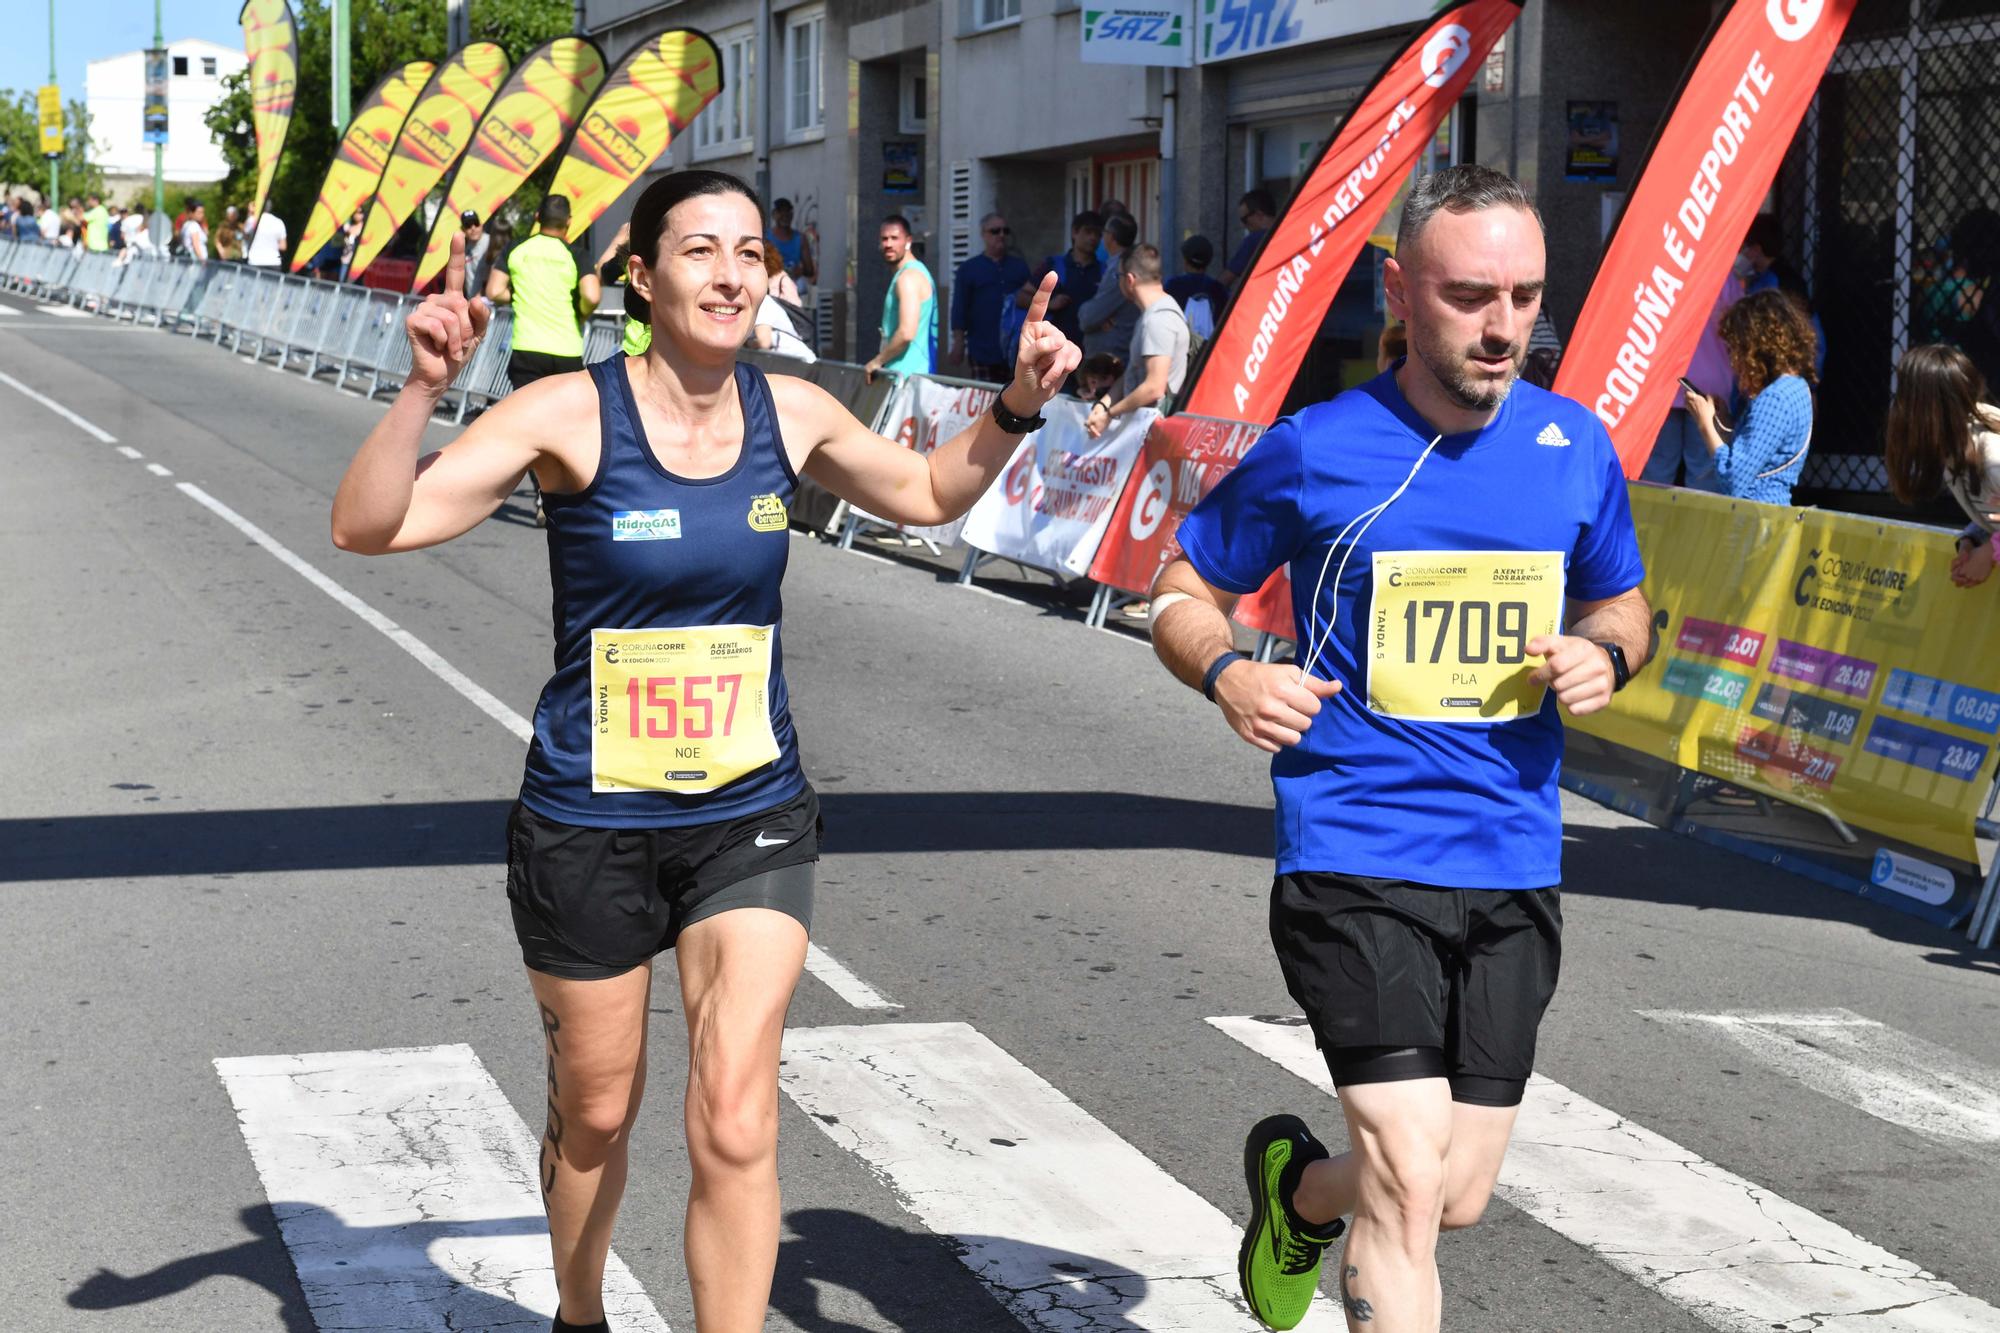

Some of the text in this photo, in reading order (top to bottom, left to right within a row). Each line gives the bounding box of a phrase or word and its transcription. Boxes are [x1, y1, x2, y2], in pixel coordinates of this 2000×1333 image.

[1114, 9, 1170, 17] MINIMARKET
[1098, 16, 1166, 41] SAZ
[485, 118, 538, 166] GADIS
[586, 115, 643, 168] GADIS
[1595, 50, 1775, 430] CORUÑA É DEPORTE
[1232, 382, 1249, 414] A
[1244, 253, 1312, 386] CORUÑA
[1536, 437, 1571, 447] adidas
[616, 517, 677, 529] HidroGAS
[1411, 579, 1436, 587] EDICIÓN
[1509, 574, 1544, 582] BARRIOS
[1819, 596, 1854, 617] EDICIÓN
[1377, 608, 1386, 649] TANDA
[1403, 600, 1528, 664] 1709
[629, 656, 655, 664] EDICIÓN
[710, 647, 753, 656] DOS BARRIOS
[1452, 673, 1478, 685] PLA
[1703, 673, 1745, 700] 22.05
[1834, 664, 1871, 690] 26.03
[599, 685, 608, 724] TANDA
[626, 674, 742, 739] 1557
[1954, 695, 2000, 724] 08.05
[1823, 709, 1855, 736] 11.09
[675, 747, 701, 759] NOE
[1941, 745, 1981, 772] 23.10
[1804, 756, 1837, 782] 27.11
[539, 1000, 564, 1238] RAQU
